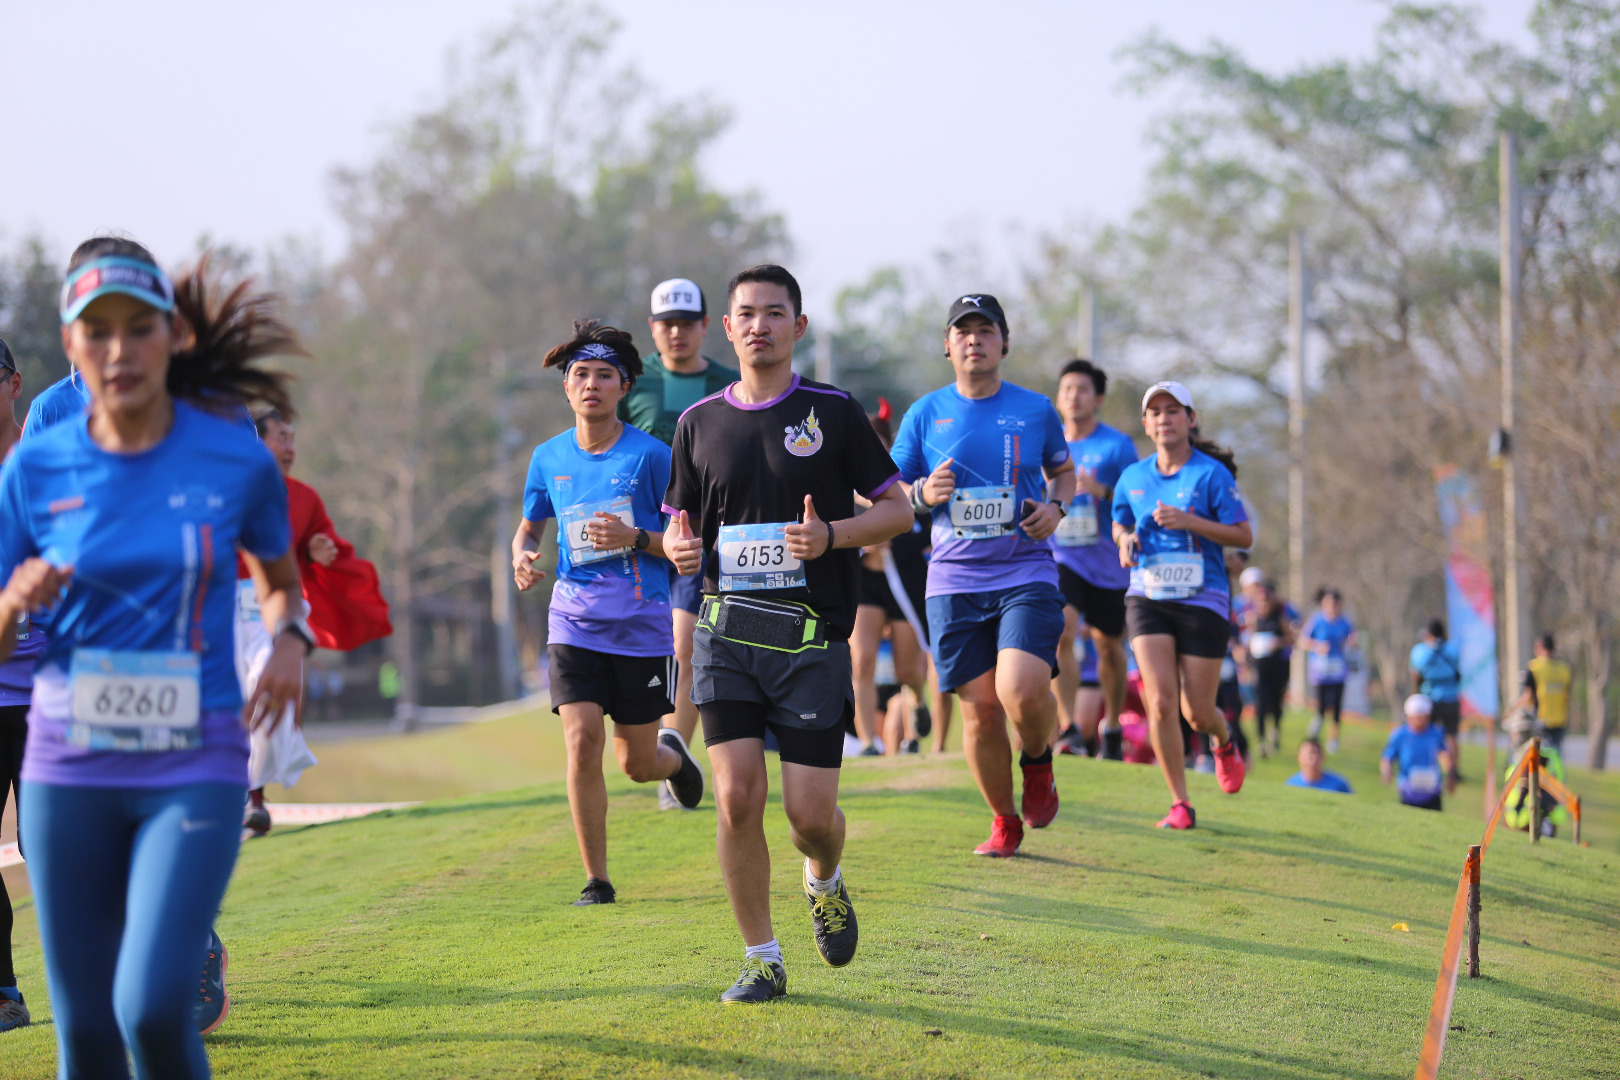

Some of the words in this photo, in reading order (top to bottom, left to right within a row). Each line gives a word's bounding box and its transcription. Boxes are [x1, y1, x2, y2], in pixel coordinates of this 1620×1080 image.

[660, 291, 693, 305] MFU
[1013, 435, 1021, 466] SINGHA
[963, 502, 1003, 521] 6001
[737, 544, 785, 568] 6153
[785, 576, 796, 587] 16
[1153, 567, 1193, 583] 6002
[723, 579, 731, 588] M
[634, 585, 642, 600] RAI
[95, 683, 178, 717] 6260
